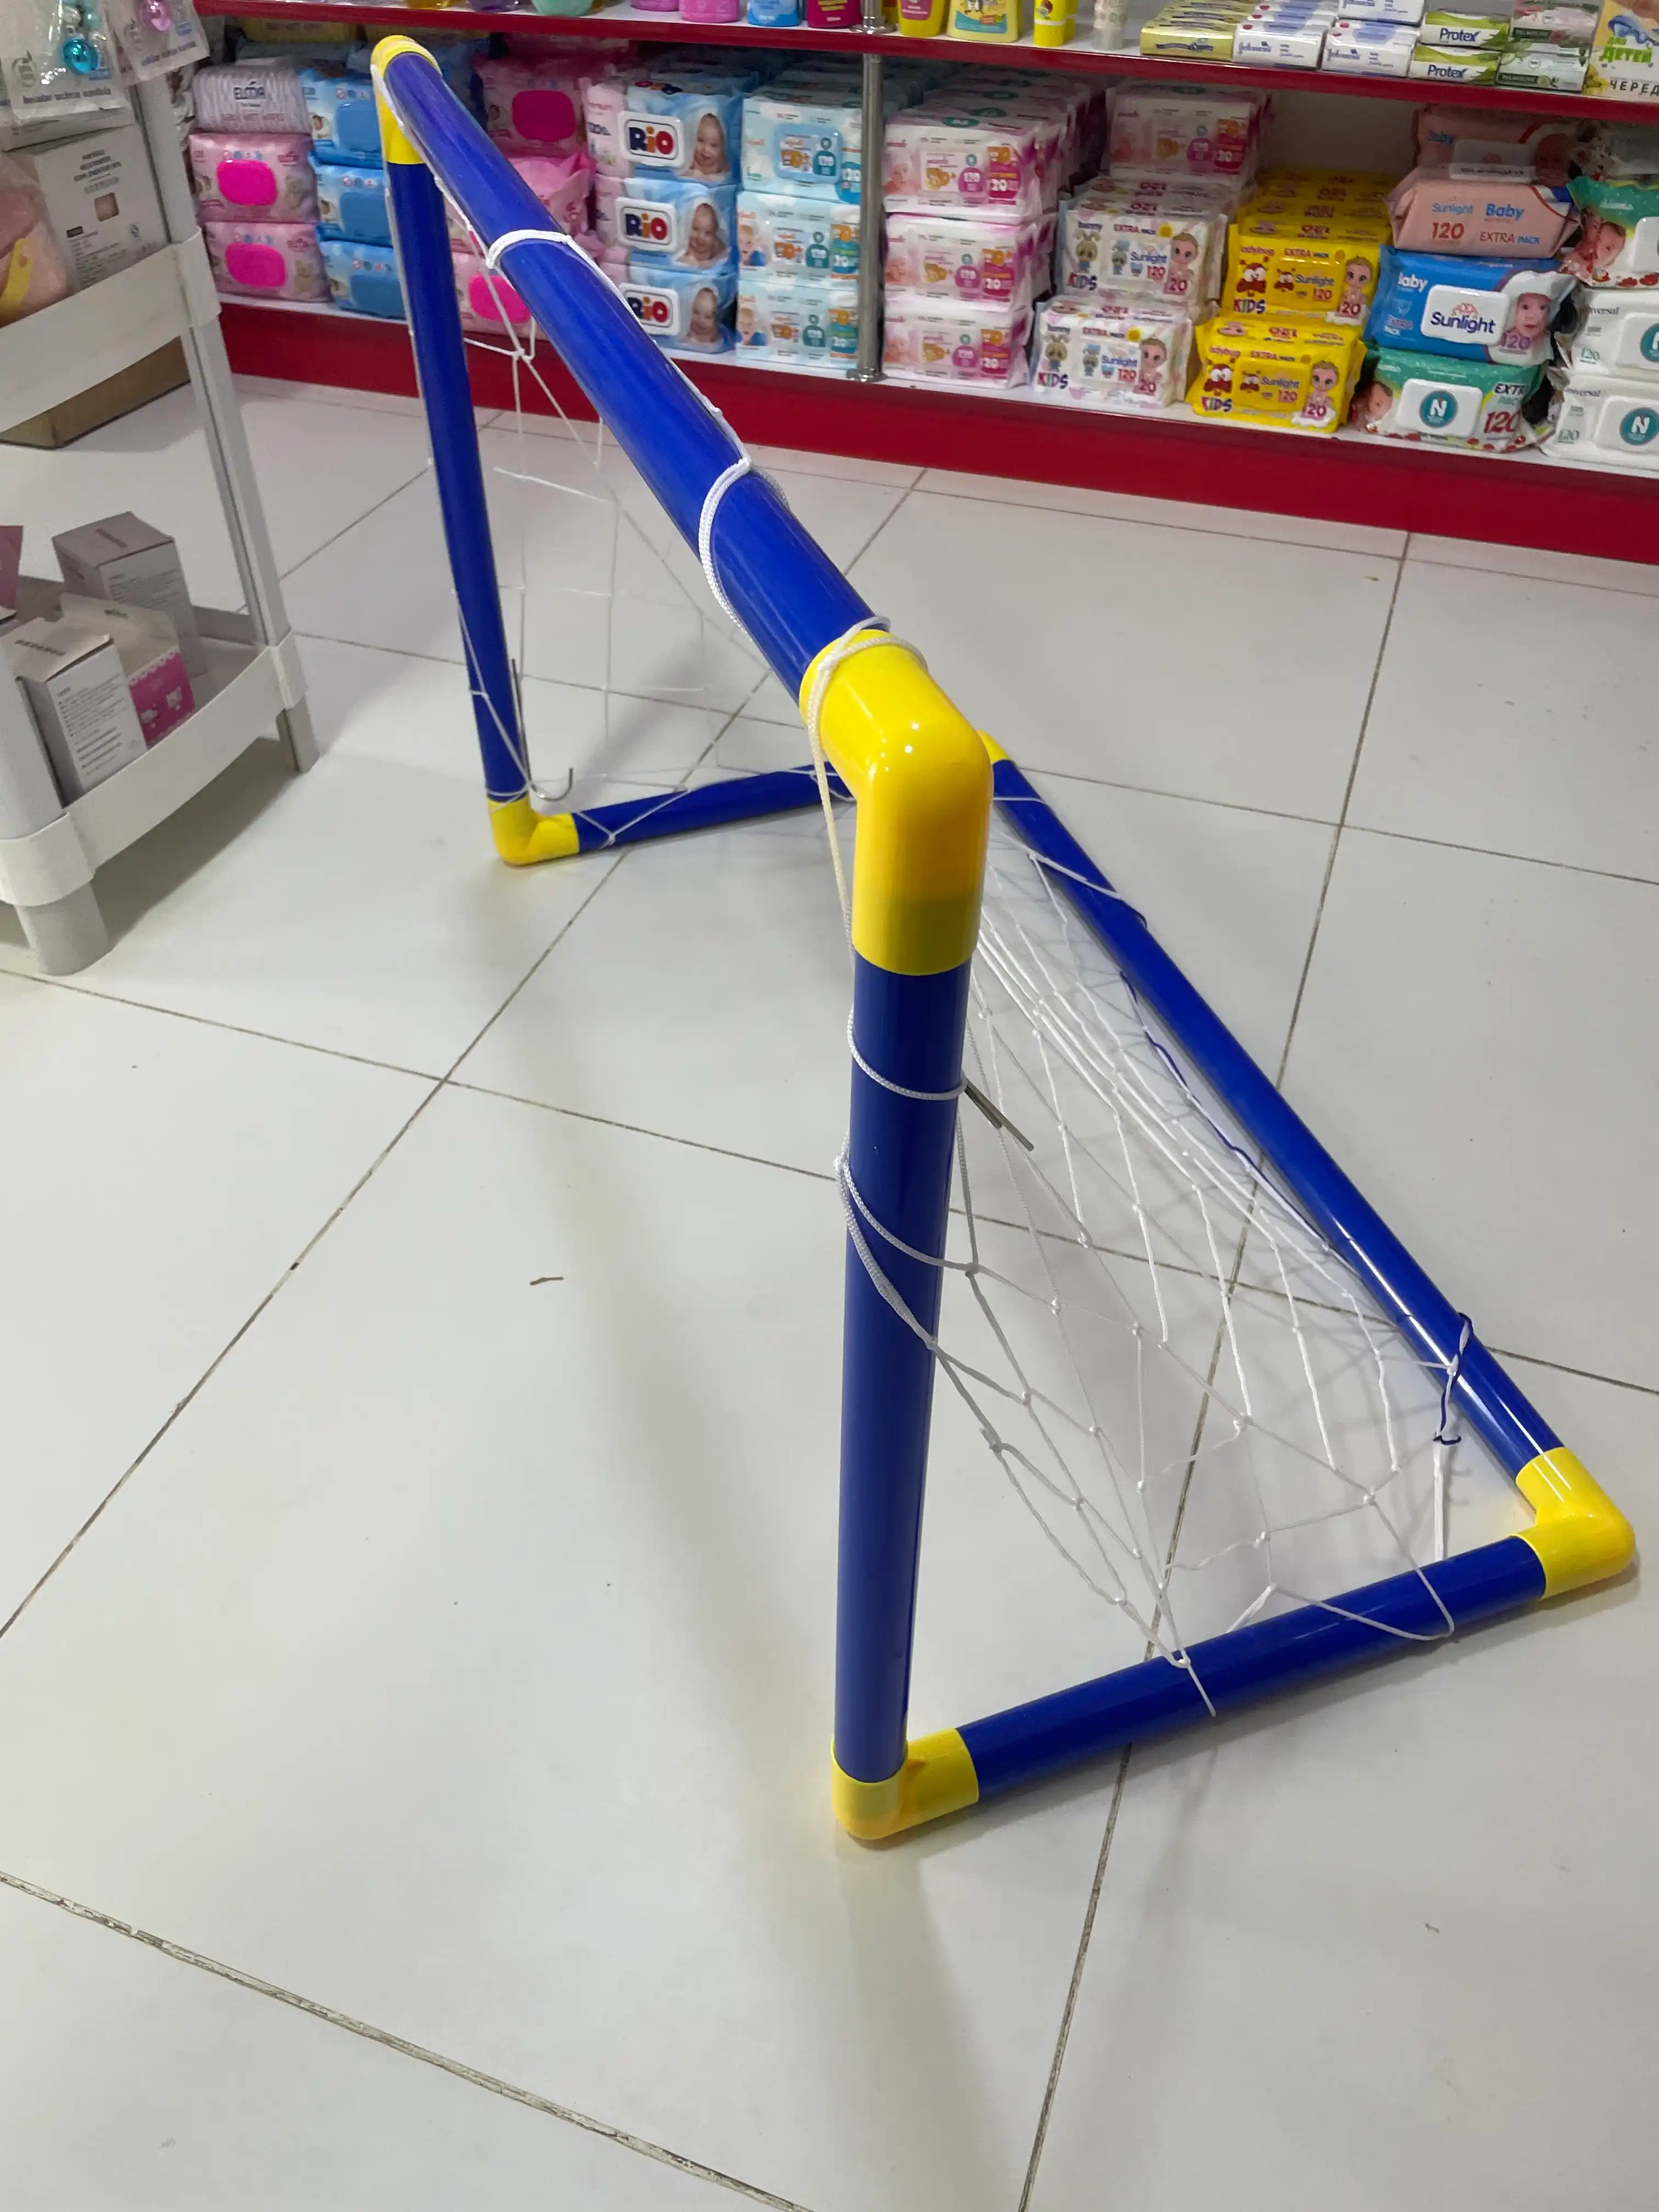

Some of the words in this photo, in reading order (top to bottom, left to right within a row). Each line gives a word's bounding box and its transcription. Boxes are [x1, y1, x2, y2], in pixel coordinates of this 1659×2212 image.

[1440, 28, 1481, 42] Protex
[1427, 64, 1469, 78] Protex
[1432, 203, 1474, 215] Sunlight
[1486, 204, 1525, 221] Baby
[1432, 222, 1465, 240] 120
[1480, 232, 1515, 242] EXTRA
[1130, 251, 1167, 264] Sunlight
[1147, 265, 1166, 280] 120
[1169, 278, 1188, 291] 20
[1295, 274, 1335, 286] Sunlight
[1313, 288, 1333, 301] 120
[1234, 298, 1266, 314] KIDS
[1339, 302, 1362, 317] 20
[1430, 311, 1496, 334] Sunlight
[1500, 332, 1532, 349] 120
[1102, 355, 1138, 367] Sunlight
[1261, 376, 1300, 389] Sunlight
[1279, 390, 1298, 403] 120
[1200, 396, 1233, 412] KIDS
[1305, 403, 1328, 417] 20
